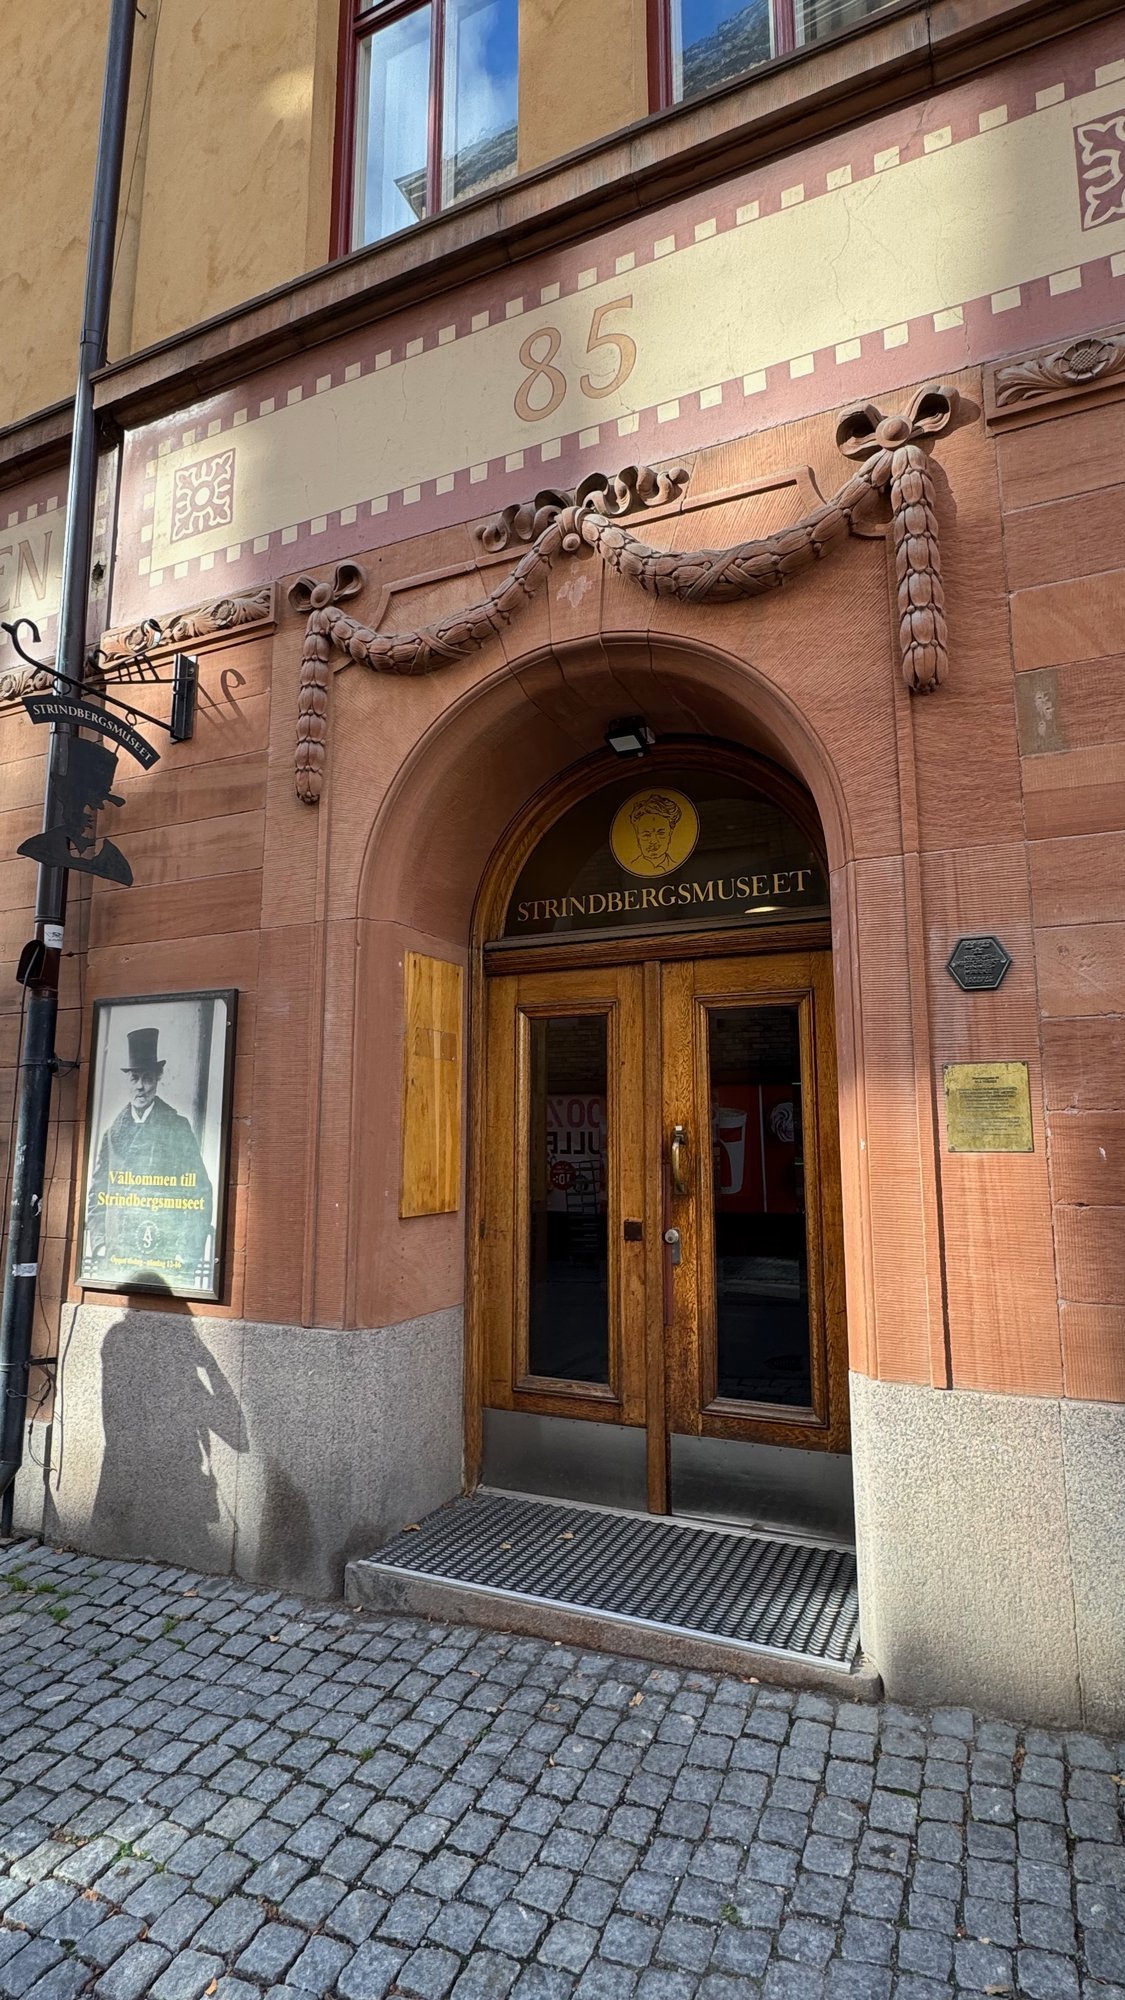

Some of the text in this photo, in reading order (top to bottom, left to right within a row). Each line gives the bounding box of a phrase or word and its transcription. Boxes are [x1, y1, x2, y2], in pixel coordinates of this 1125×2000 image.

[513, 294, 637, 422] 85
[32, 703, 153, 762] STRINDBERGSMUSEET
[517, 869, 812, 922] STRINDBERGSMUSEET
[97, 1191, 205, 1211] Strindbergsmuseet
[108, 1170, 197, 1188] Välkommen till
